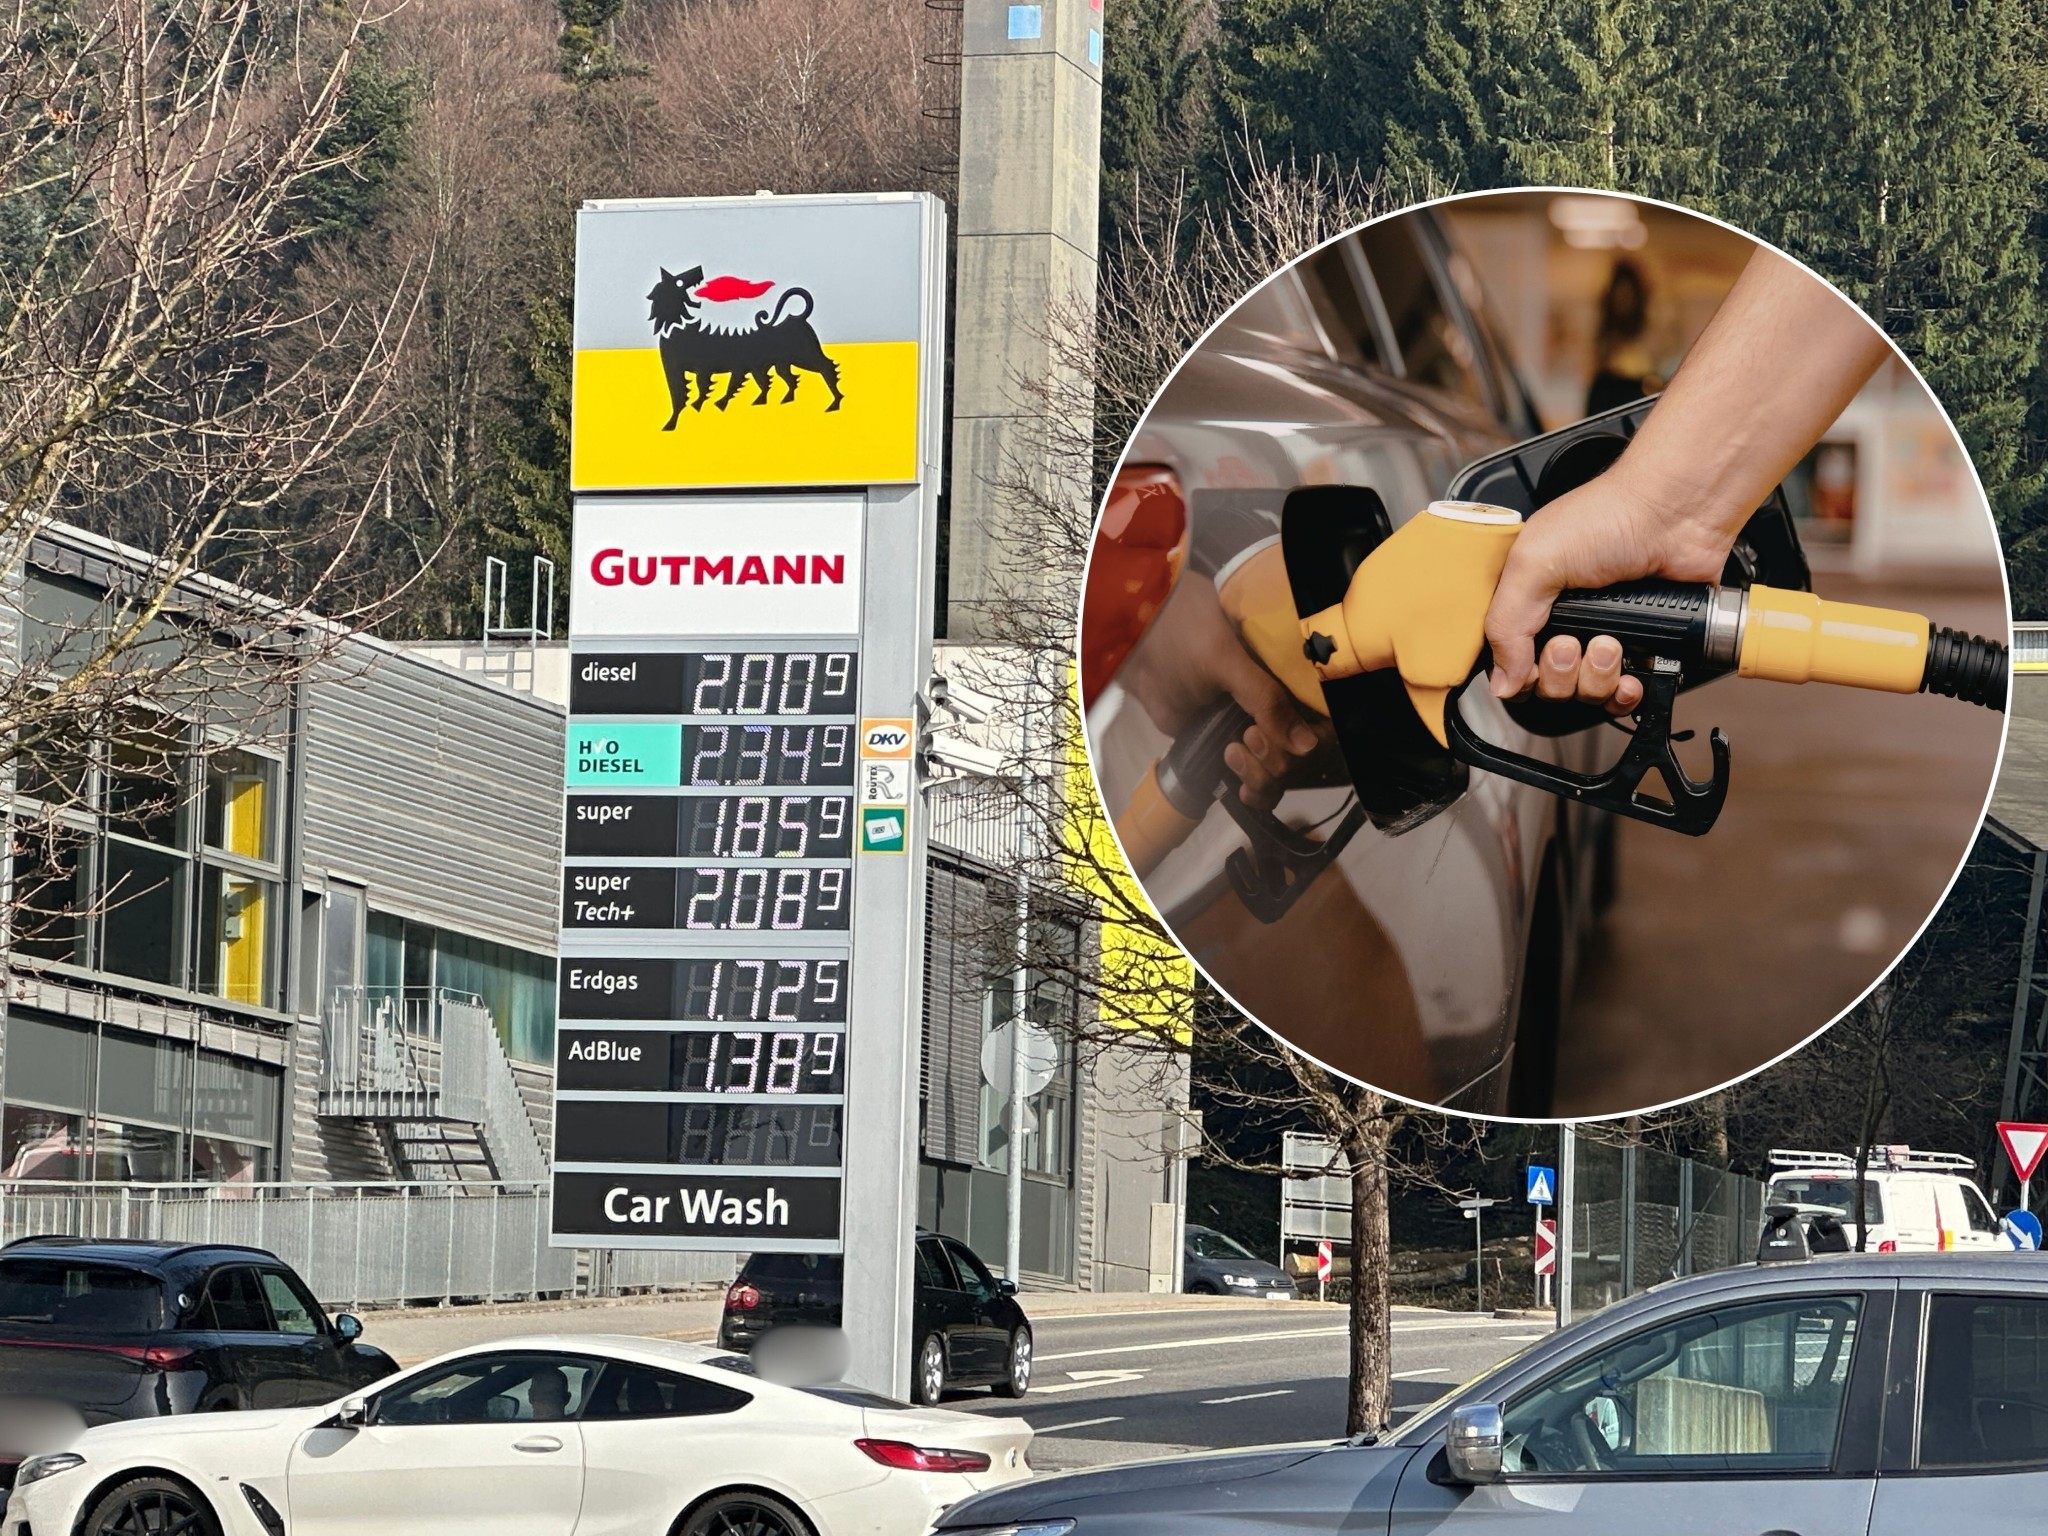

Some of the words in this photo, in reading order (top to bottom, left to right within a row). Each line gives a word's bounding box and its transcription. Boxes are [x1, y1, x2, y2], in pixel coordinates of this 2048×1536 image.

[590, 548, 844, 587] GUTMANN
[581, 661, 637, 683] diesel
[868, 733, 906, 745] DKV
[578, 758, 644, 773] DIESEL
[868, 765, 878, 800] ROUTEX
[576, 803, 632, 825] super
[574, 873, 631, 894] super
[573, 900, 635, 921] Tech+
[569, 969, 639, 994] Erdgas
[568, 1040, 642, 1062] AdBlue
[603, 1187, 670, 1223] Car
[680, 1187, 789, 1226] Wash
